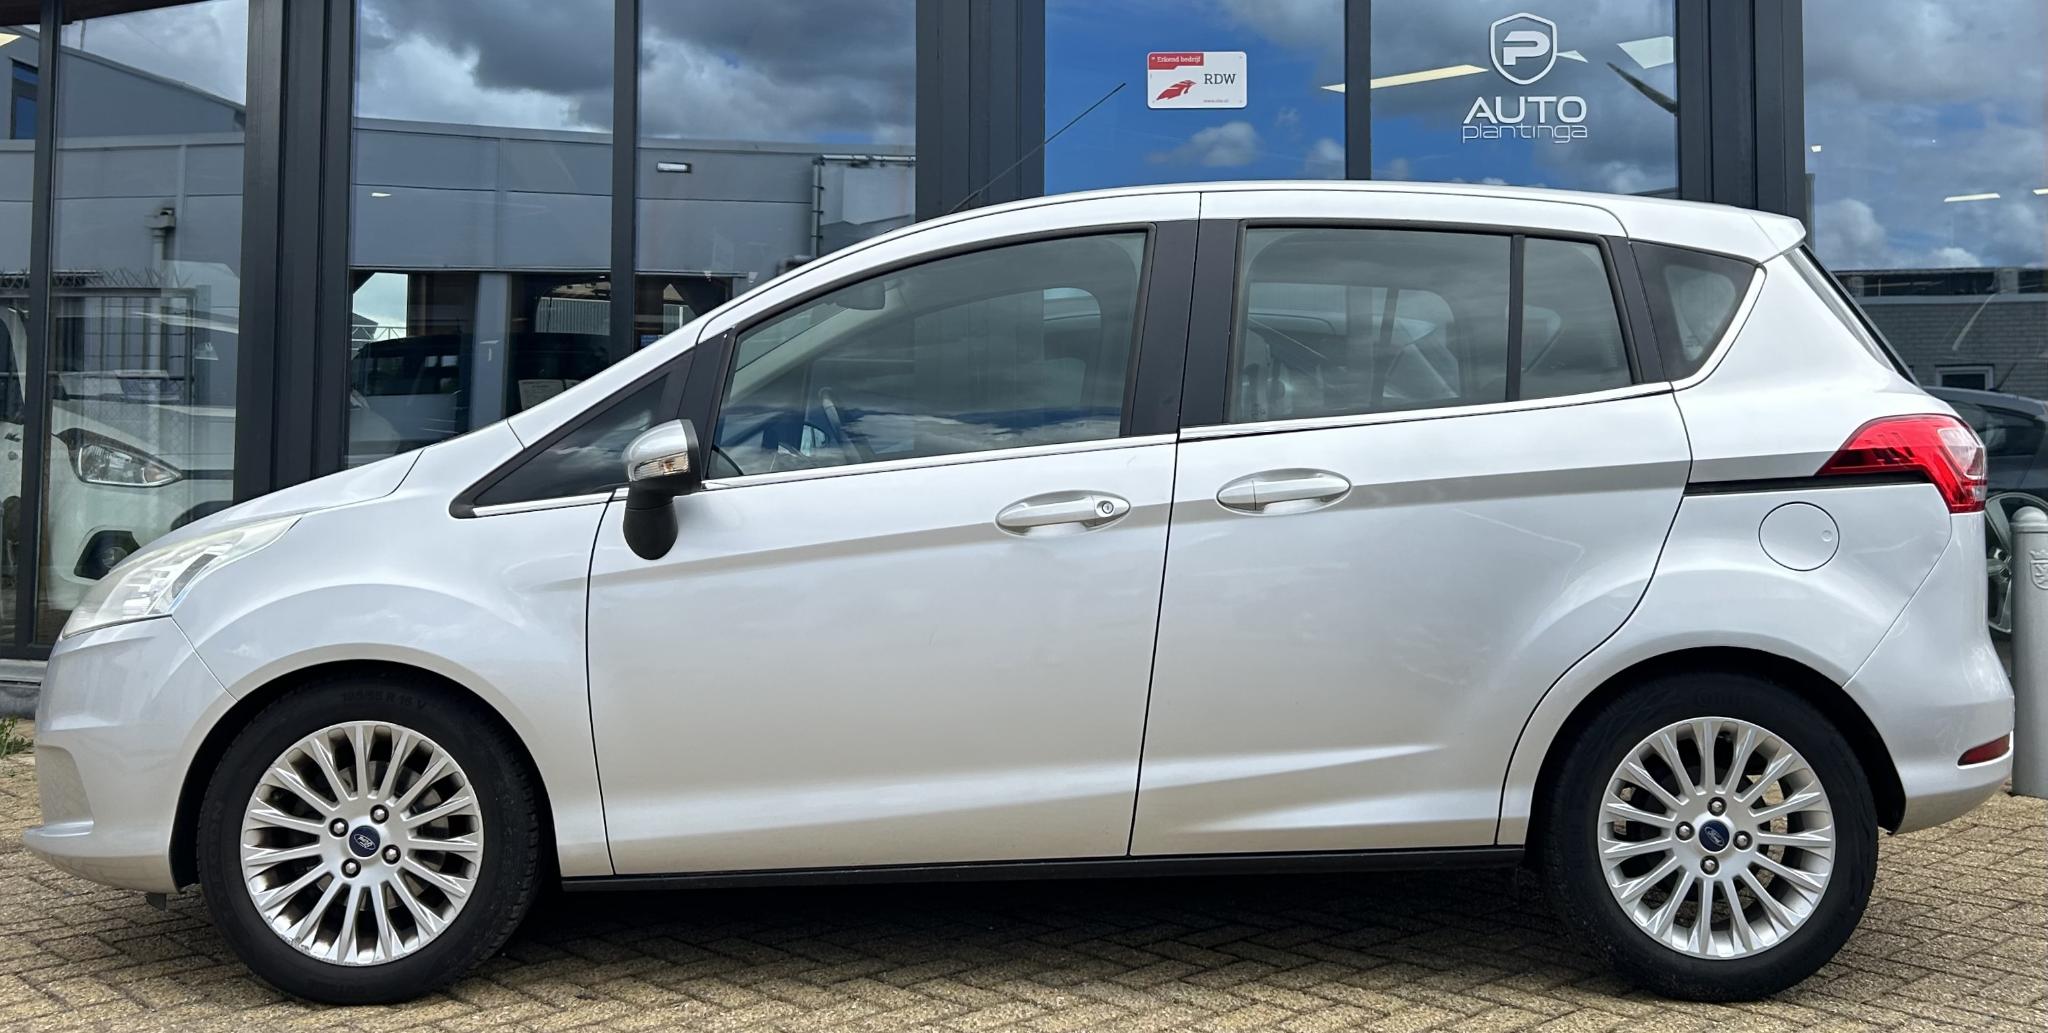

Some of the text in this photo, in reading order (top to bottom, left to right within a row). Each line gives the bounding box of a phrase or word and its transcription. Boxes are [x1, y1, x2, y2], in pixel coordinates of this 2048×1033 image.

[1503, 30, 1550, 66] P
[1204, 73, 1236, 85] RDW
[1463, 96, 1587, 124] AUTO
[1462, 123, 1588, 144] plantinga
